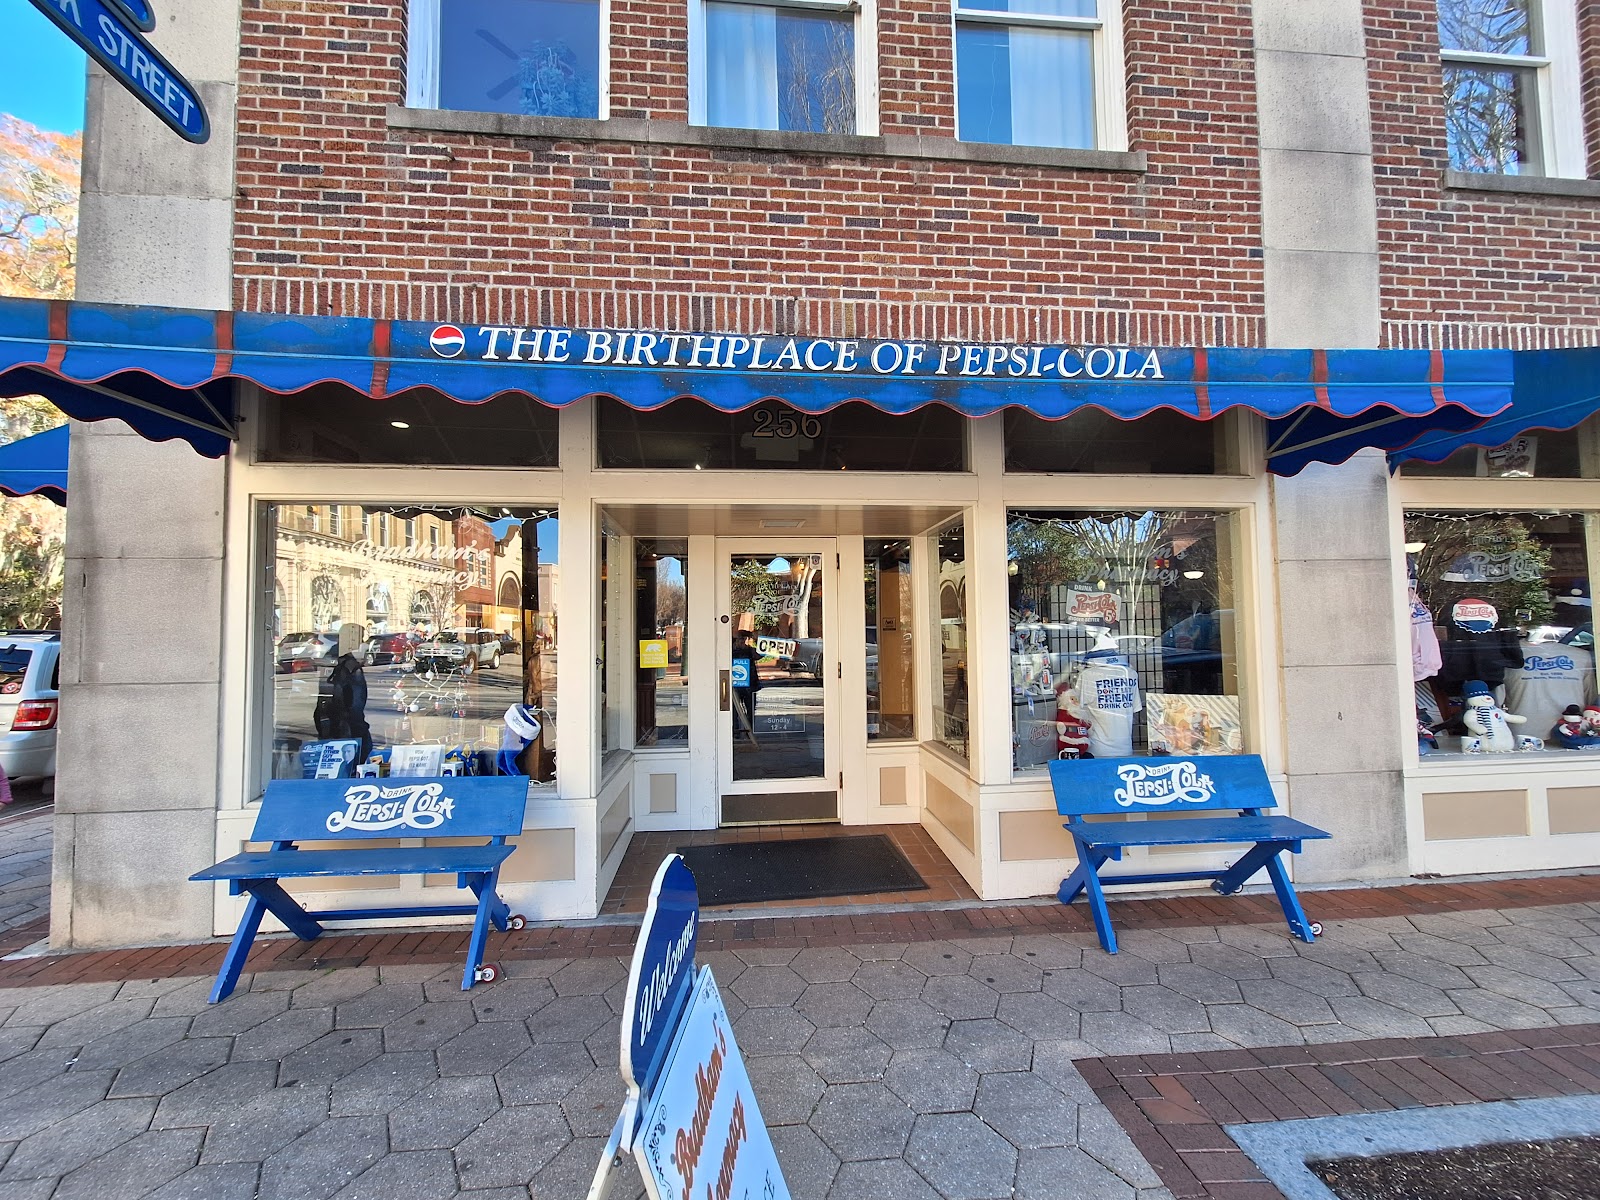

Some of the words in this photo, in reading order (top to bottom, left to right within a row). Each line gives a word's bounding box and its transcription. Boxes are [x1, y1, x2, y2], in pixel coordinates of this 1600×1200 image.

[97, 13, 195, 127] STREET
[478, 326, 572, 362] THE
[582, 330, 859, 372] BIRTHPLACE
[870, 338, 928, 375] OF
[934, 344, 1165, 380] PEPSI-COLA
[752, 408, 822, 439] 256
[1074, 584, 1093, 592] DRINK
[759, 639, 794, 657] OPEN
[1095, 678, 1137, 689] FRIENDS
[1152, 765, 1171, 776] DRINK
[386, 787, 413, 798] DRINK
[639, 910, 696, 1047] Welcome
[674, 1018, 727, 1200] Bradham's
